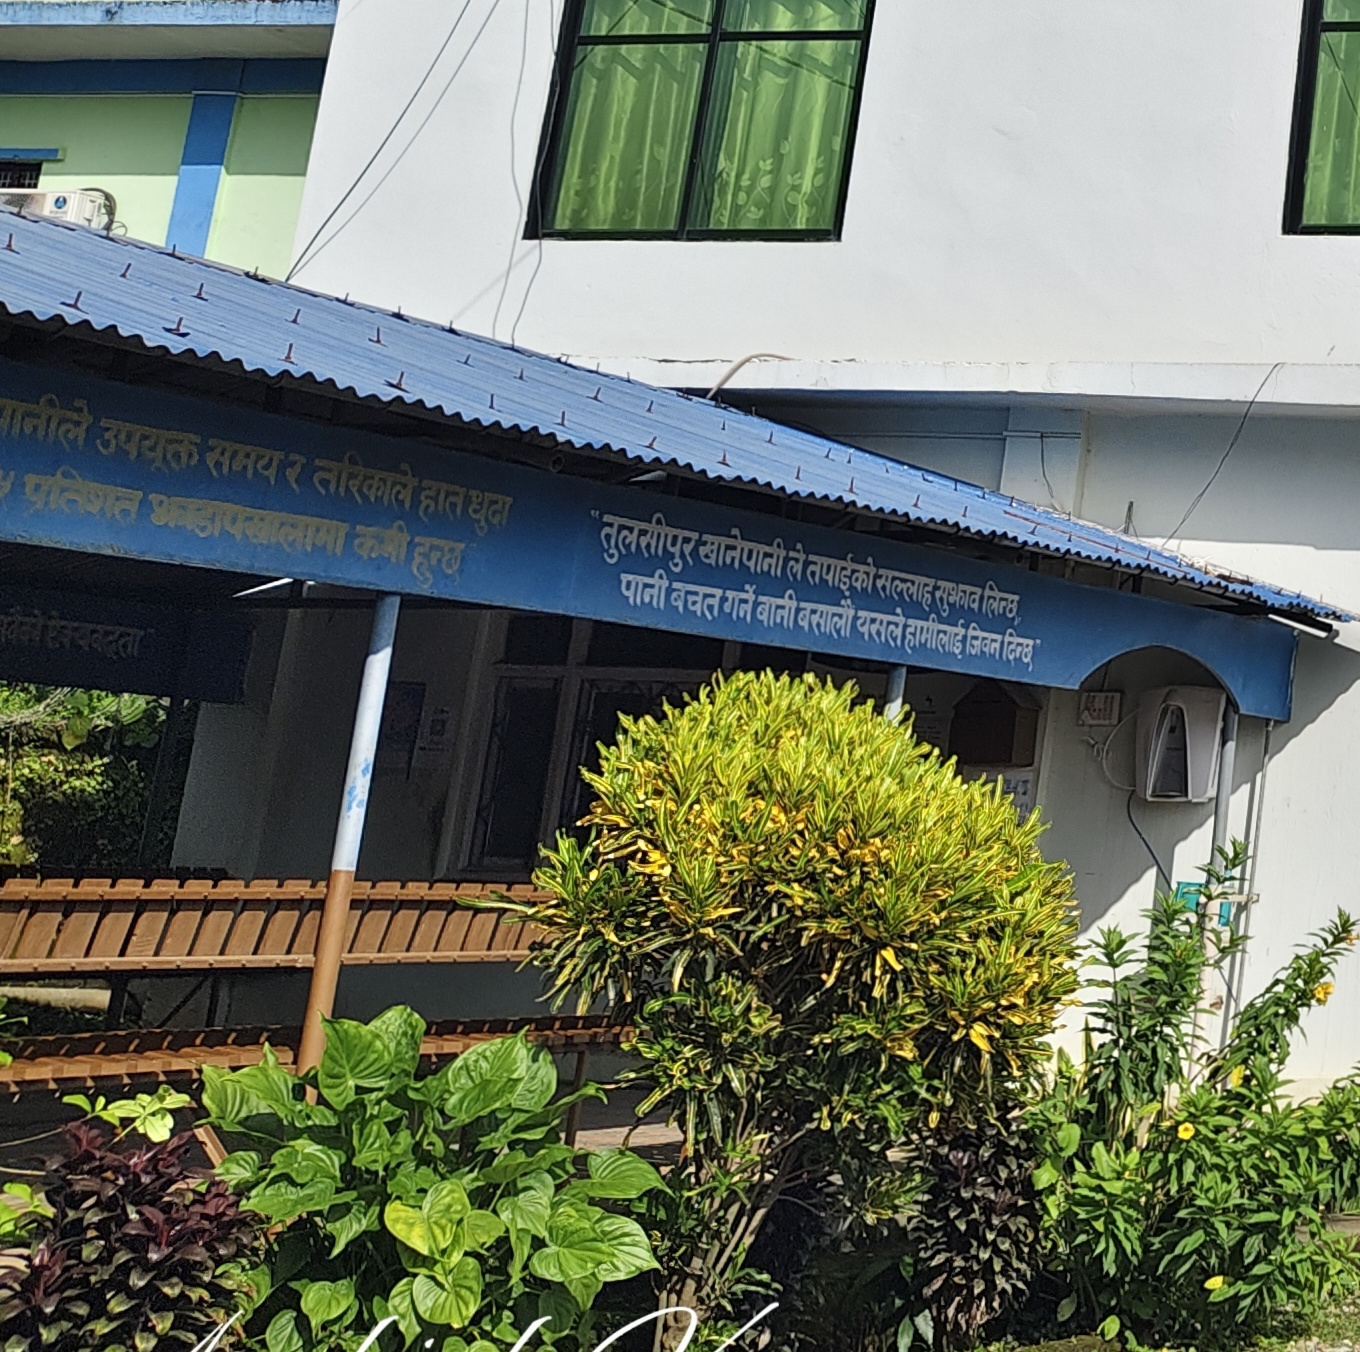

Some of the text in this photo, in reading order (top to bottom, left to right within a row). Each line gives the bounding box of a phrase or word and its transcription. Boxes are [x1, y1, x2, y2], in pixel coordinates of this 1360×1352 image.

[205, 438, 285, 486] समय
[286, 455, 307, 492] र
[419, 479, 467, 523] हात
[699, 527, 787, 578] खानेपानी
[876, 568, 936, 611] सल्लाह
[620, 568, 669, 610] पानी
[670, 581, 723, 621] बचत
[723, 584, 756, 625] गर्ने
[757, 589, 797, 631] बानी
[856, 607, 906, 648] यसले
[905, 613, 966, 659] हामीलाई
[966, 623, 1003, 660] जिवन
